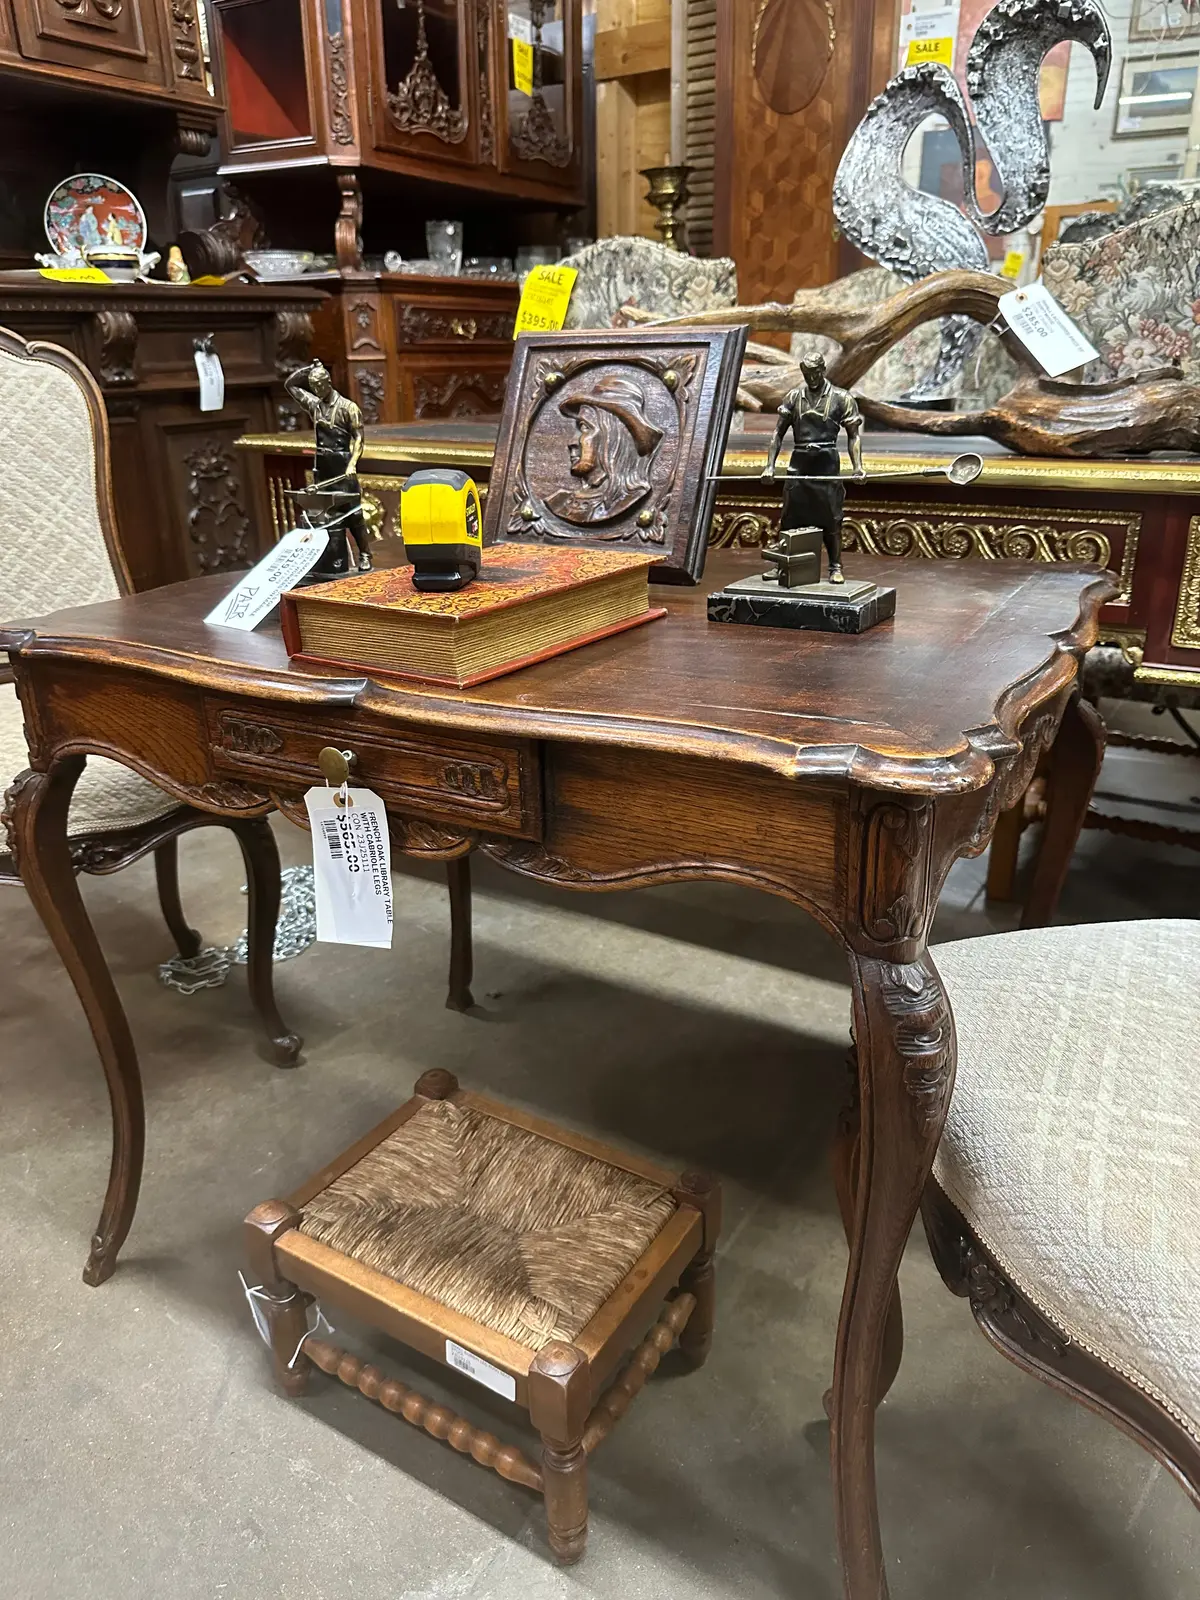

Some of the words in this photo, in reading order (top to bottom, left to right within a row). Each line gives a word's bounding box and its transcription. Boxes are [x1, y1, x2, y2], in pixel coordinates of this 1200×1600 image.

[916, 42, 940, 53] SALE
[538, 271, 565, 286] SALE
[268, 547, 304, 583] $219.00
[229, 586, 260, 619] PAIR
[360, 812, 373, 833] WITH
[368, 811, 382, 843] FRENCH
[336, 814, 360, 873] $565.00
[351, 813, 361, 831] CON
[357, 834, 370, 873] 23J25111
[366, 834, 378, 874] CABRIOLE
[376, 844, 386, 862] OAK
[373, 875, 382, 896] LEGS
[379, 863, 390, 897] LIBRARY
[384, 899, 393, 924] TABLE
